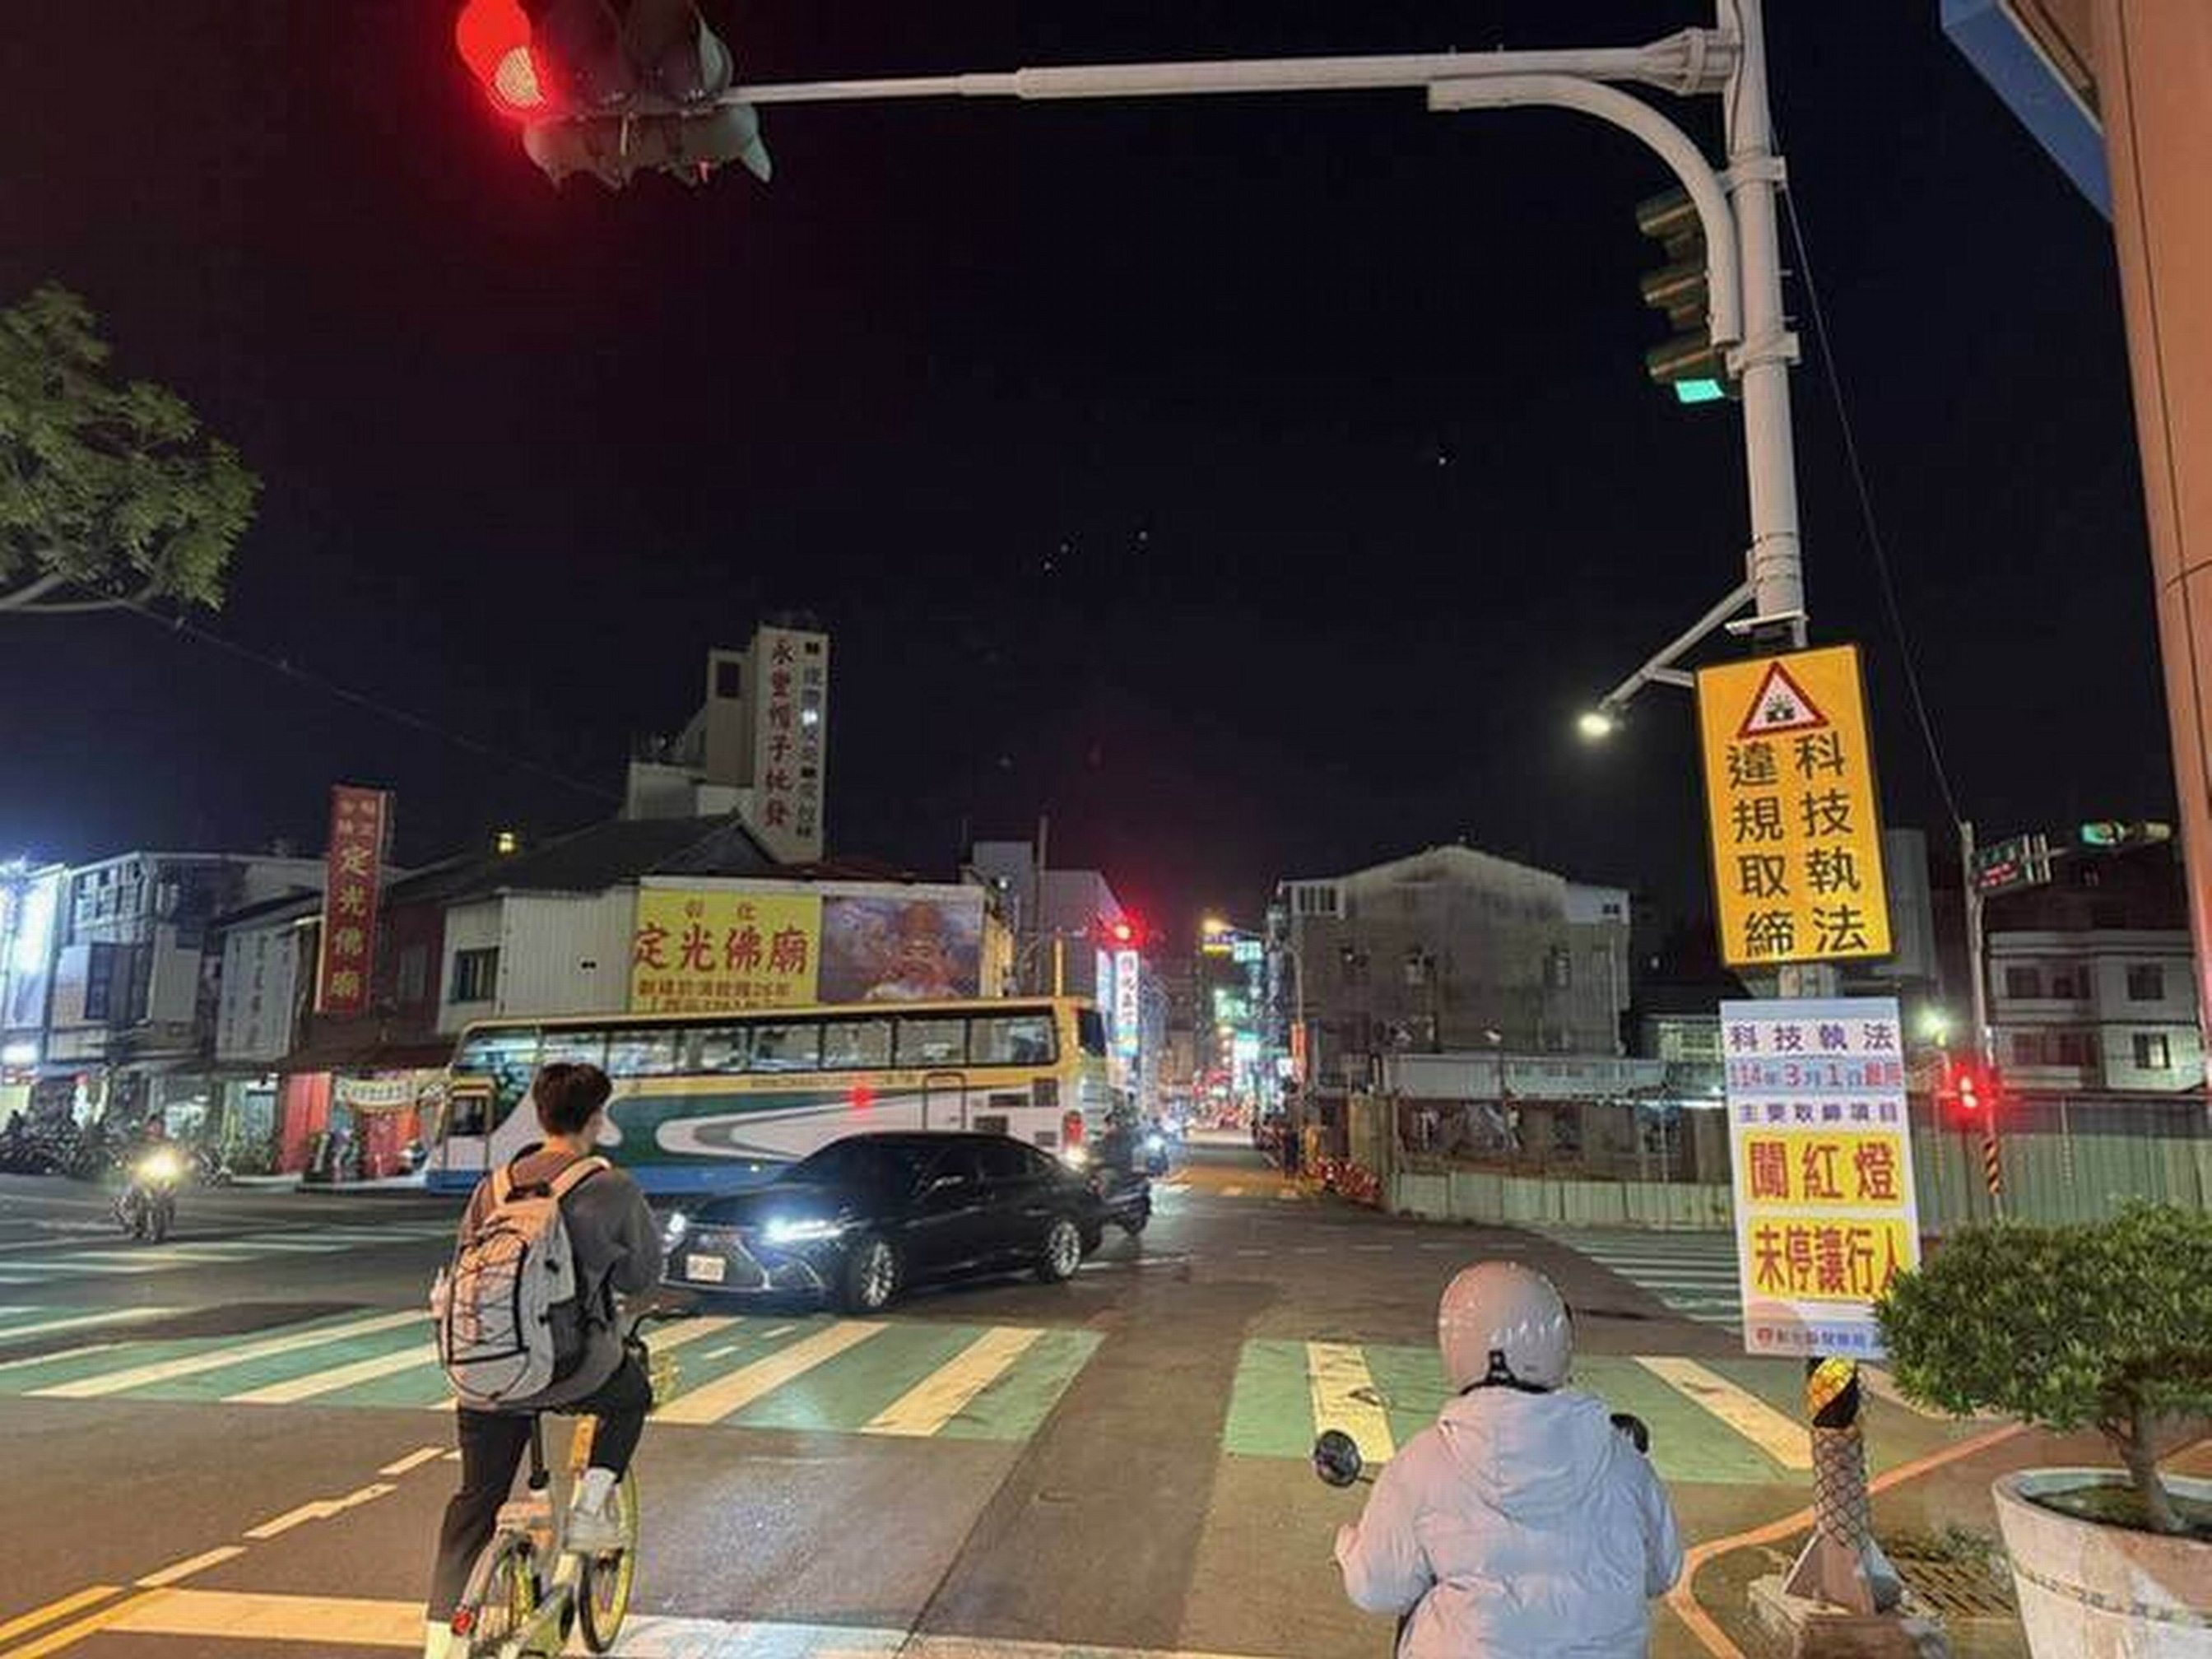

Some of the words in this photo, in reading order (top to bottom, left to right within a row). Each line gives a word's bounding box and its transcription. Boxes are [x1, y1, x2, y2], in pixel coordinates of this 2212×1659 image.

[1726, 742, 1795, 958] 違規取締
[1794, 731, 1868, 953] 科技執法
[634, 922, 808, 974] 定光佛廟
[1730, 1023, 1894, 1053] 科技執法
[1749, 1141, 1898, 1201] 闖紅燈
[1754, 1224, 1899, 1295] 未停讓行人
